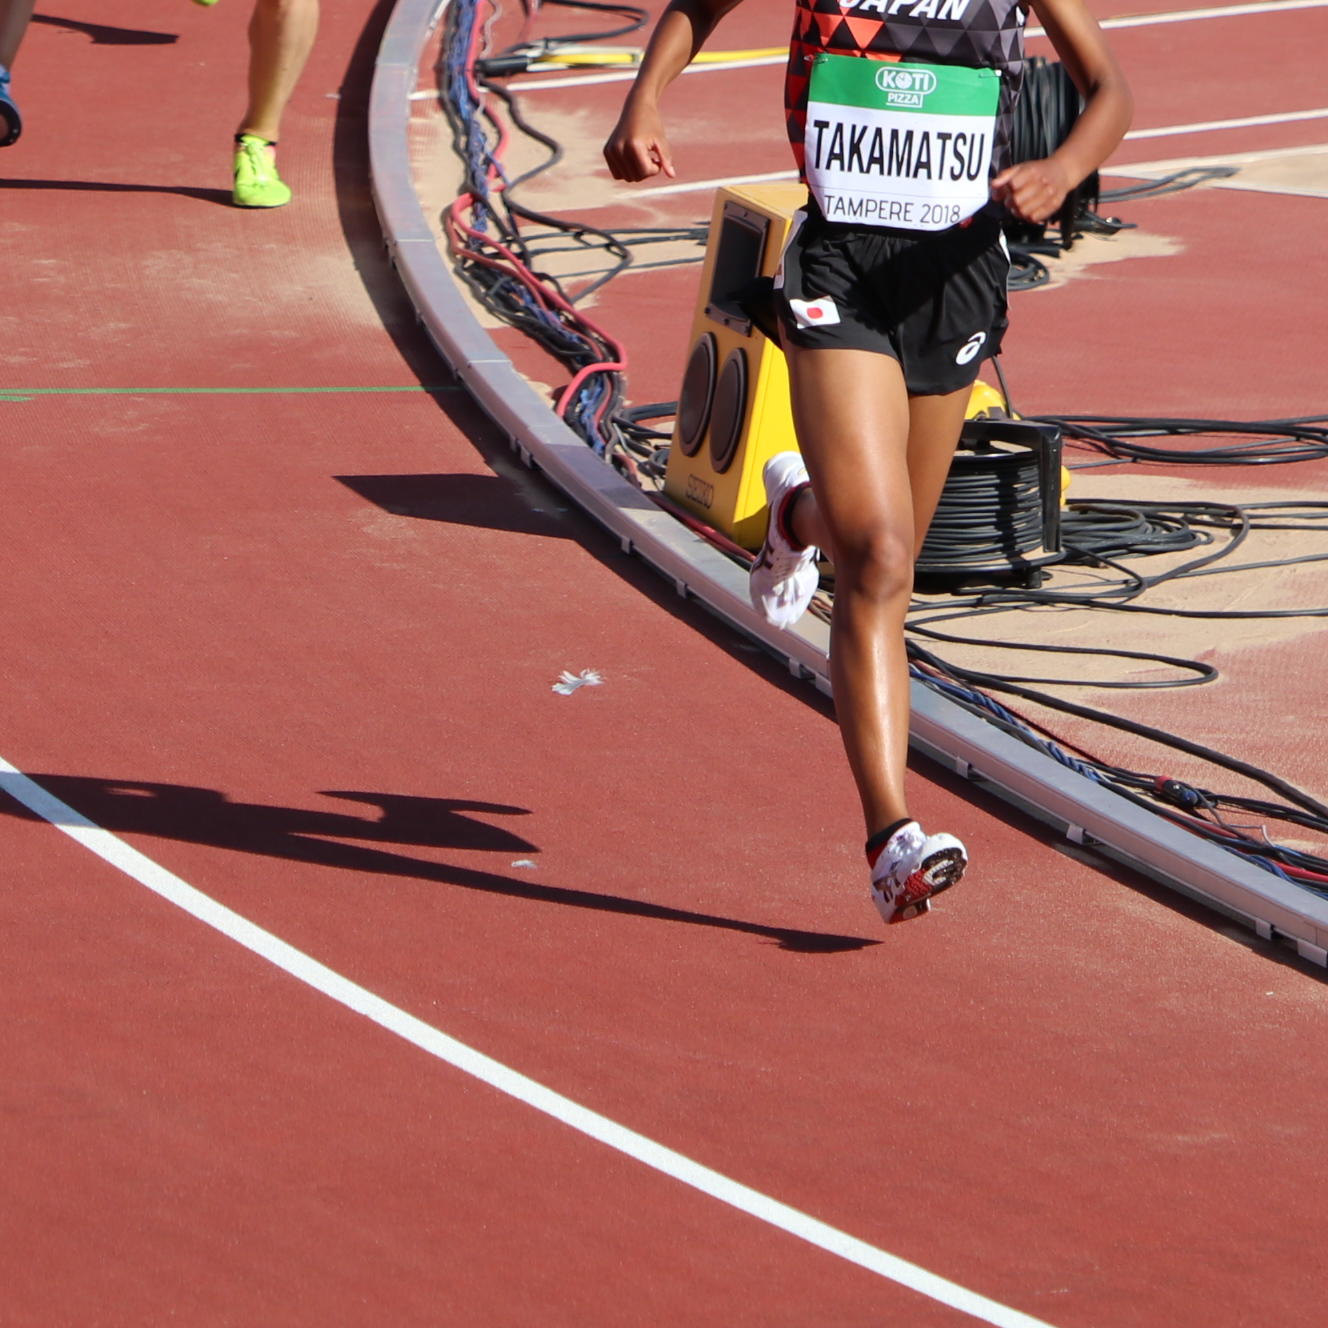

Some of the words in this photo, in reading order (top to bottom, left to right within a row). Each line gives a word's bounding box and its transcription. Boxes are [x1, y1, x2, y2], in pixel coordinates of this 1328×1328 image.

[882, 69, 930, 91] KOTI
[888, 92, 920, 106] PIZZA
[814, 119, 985, 182] TAKAMATSU
[824, 195, 914, 223] TAMPERE
[919, 203, 961, 224] 2018
